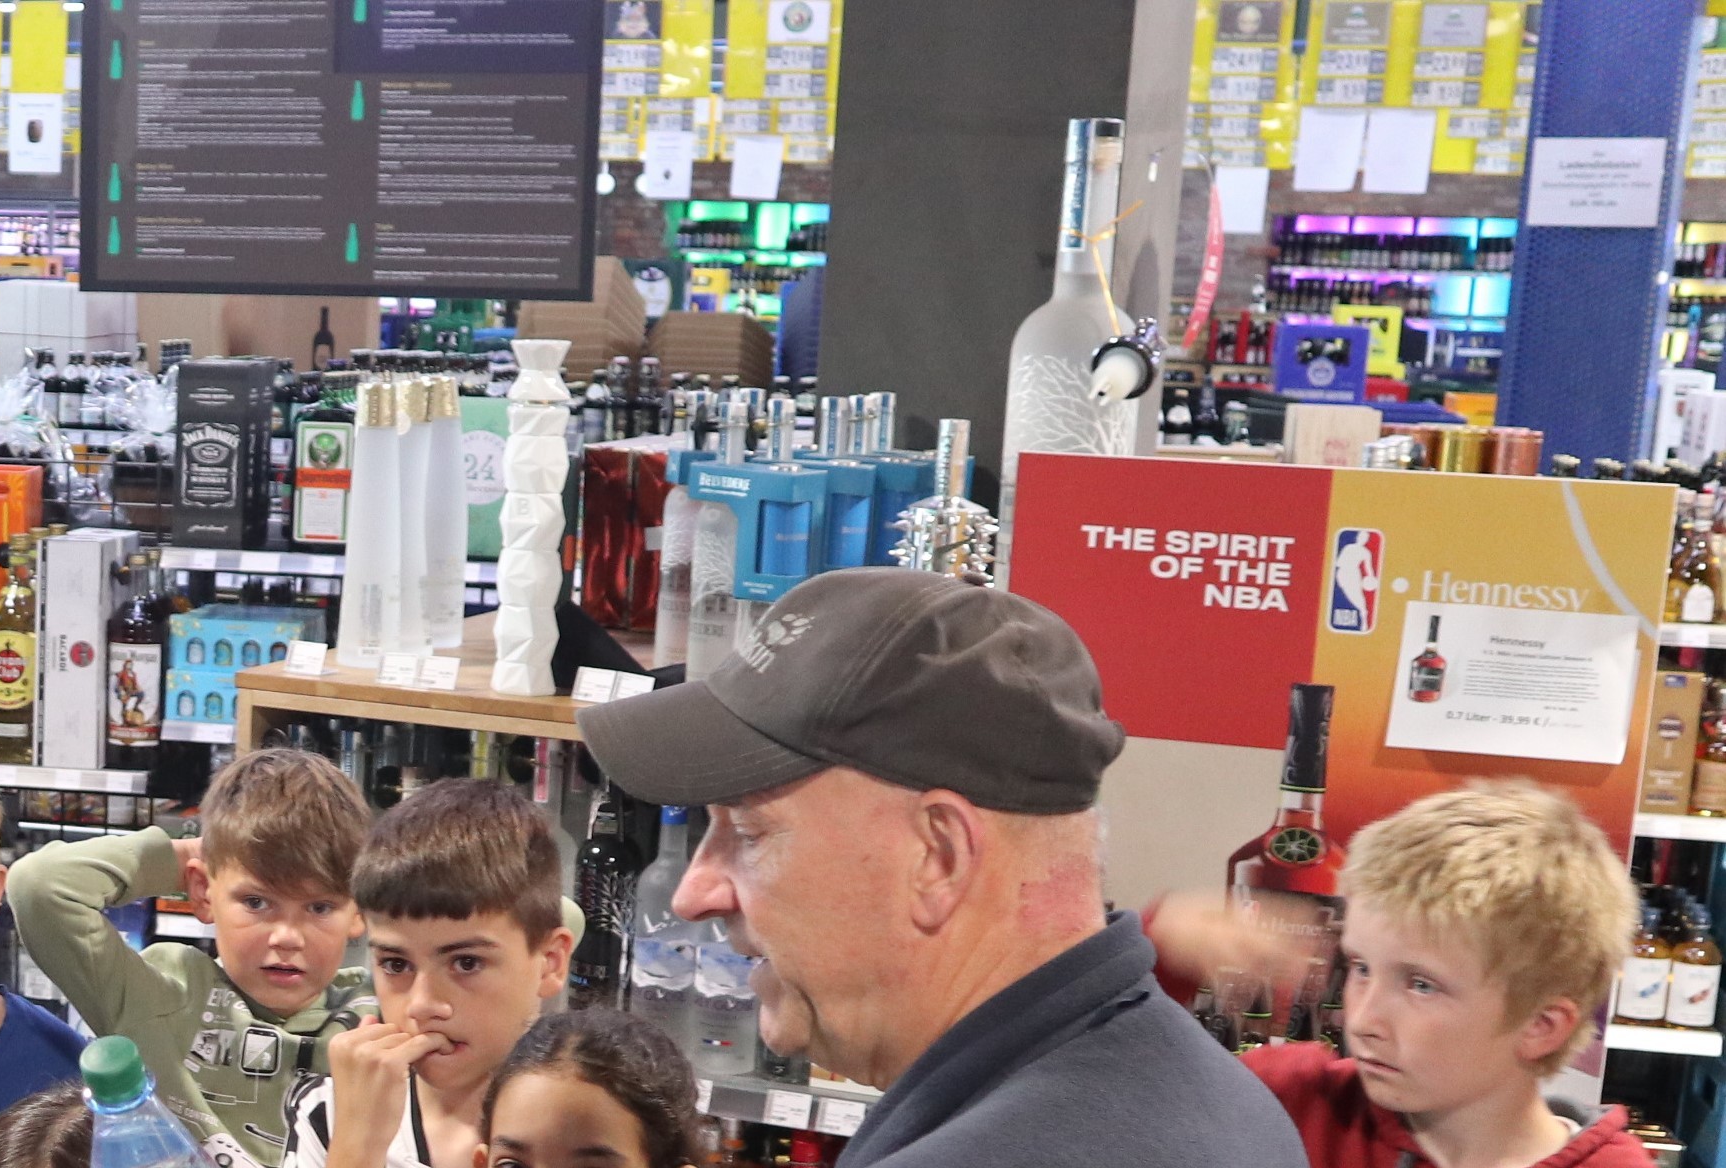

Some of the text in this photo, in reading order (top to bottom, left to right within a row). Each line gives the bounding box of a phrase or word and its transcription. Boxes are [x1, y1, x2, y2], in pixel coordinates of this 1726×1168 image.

[464, 453, 495, 481] 24
[1080, 524, 1295, 560] THE SPIRIT
[1150, 554, 1293, 587] OF THE
[1204, 583, 1289, 612] NBA
[1421, 570, 1590, 612] Hennessy
[1334, 609, 1359, 628] NBA
[1490, 635, 1547, 650] Hennessy
[1465, 711, 1491, 722] Liter
